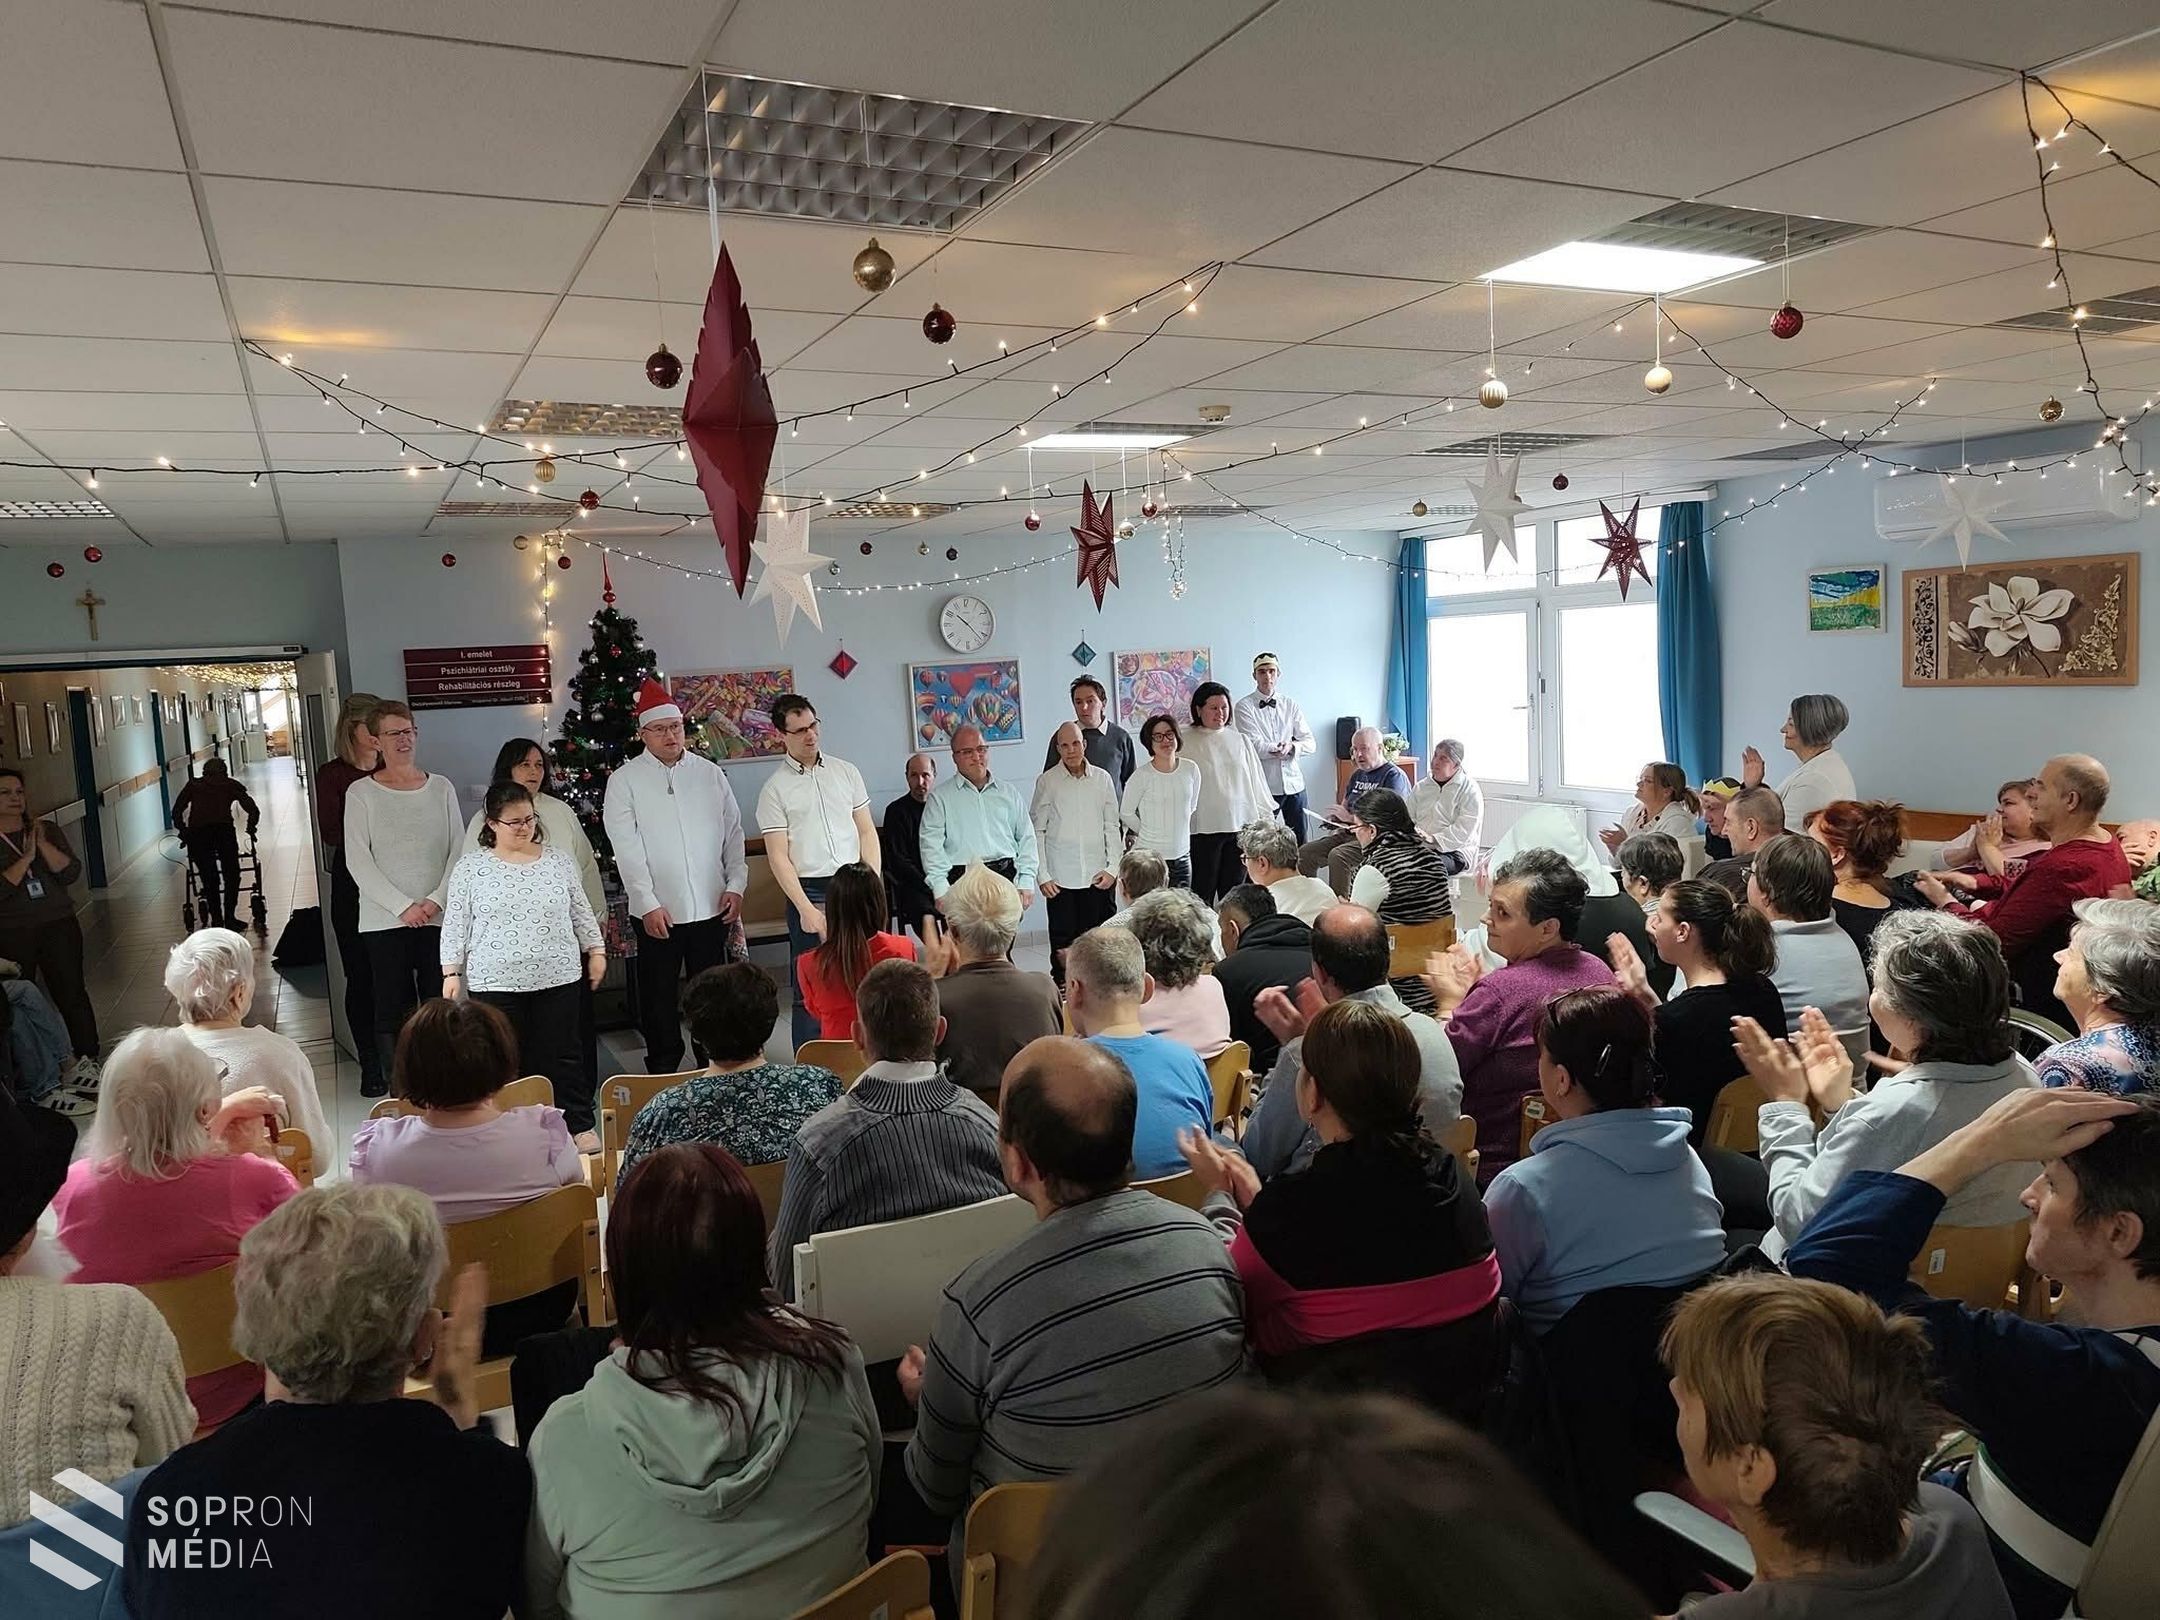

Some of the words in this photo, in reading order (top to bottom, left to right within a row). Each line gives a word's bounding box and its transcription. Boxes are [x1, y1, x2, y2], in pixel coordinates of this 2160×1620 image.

[467, 650, 493, 658] emelet
[440, 666, 487, 675] Pszichiátriai
[489, 664, 515, 674] osztály
[438, 681, 492, 691] Rehabilitációs
[493, 679, 521, 689] részleg
